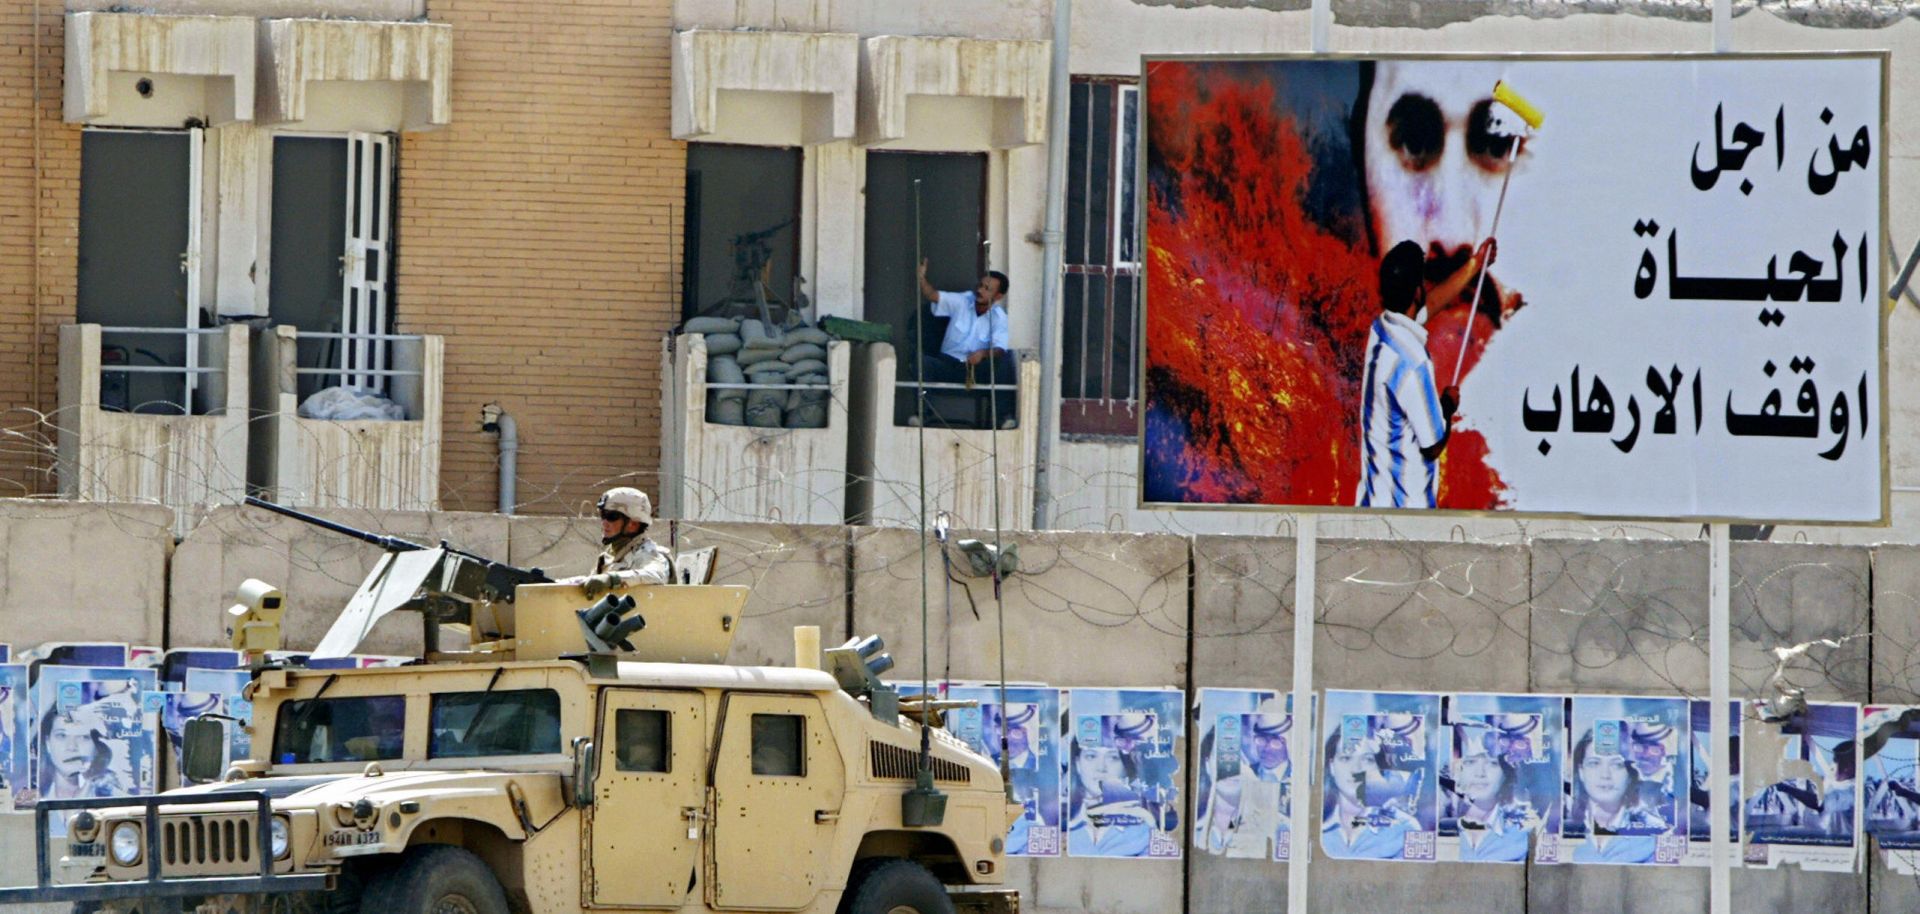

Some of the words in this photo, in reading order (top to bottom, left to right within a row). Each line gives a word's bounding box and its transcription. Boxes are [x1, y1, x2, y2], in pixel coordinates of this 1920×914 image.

[1690, 101, 1785, 196] اجل
[1807, 106, 1871, 196] من
[1633, 218, 1868, 327] الحياة
[1522, 363, 1703, 457] الارهاب
[1726, 355, 1868, 461] اوقف
